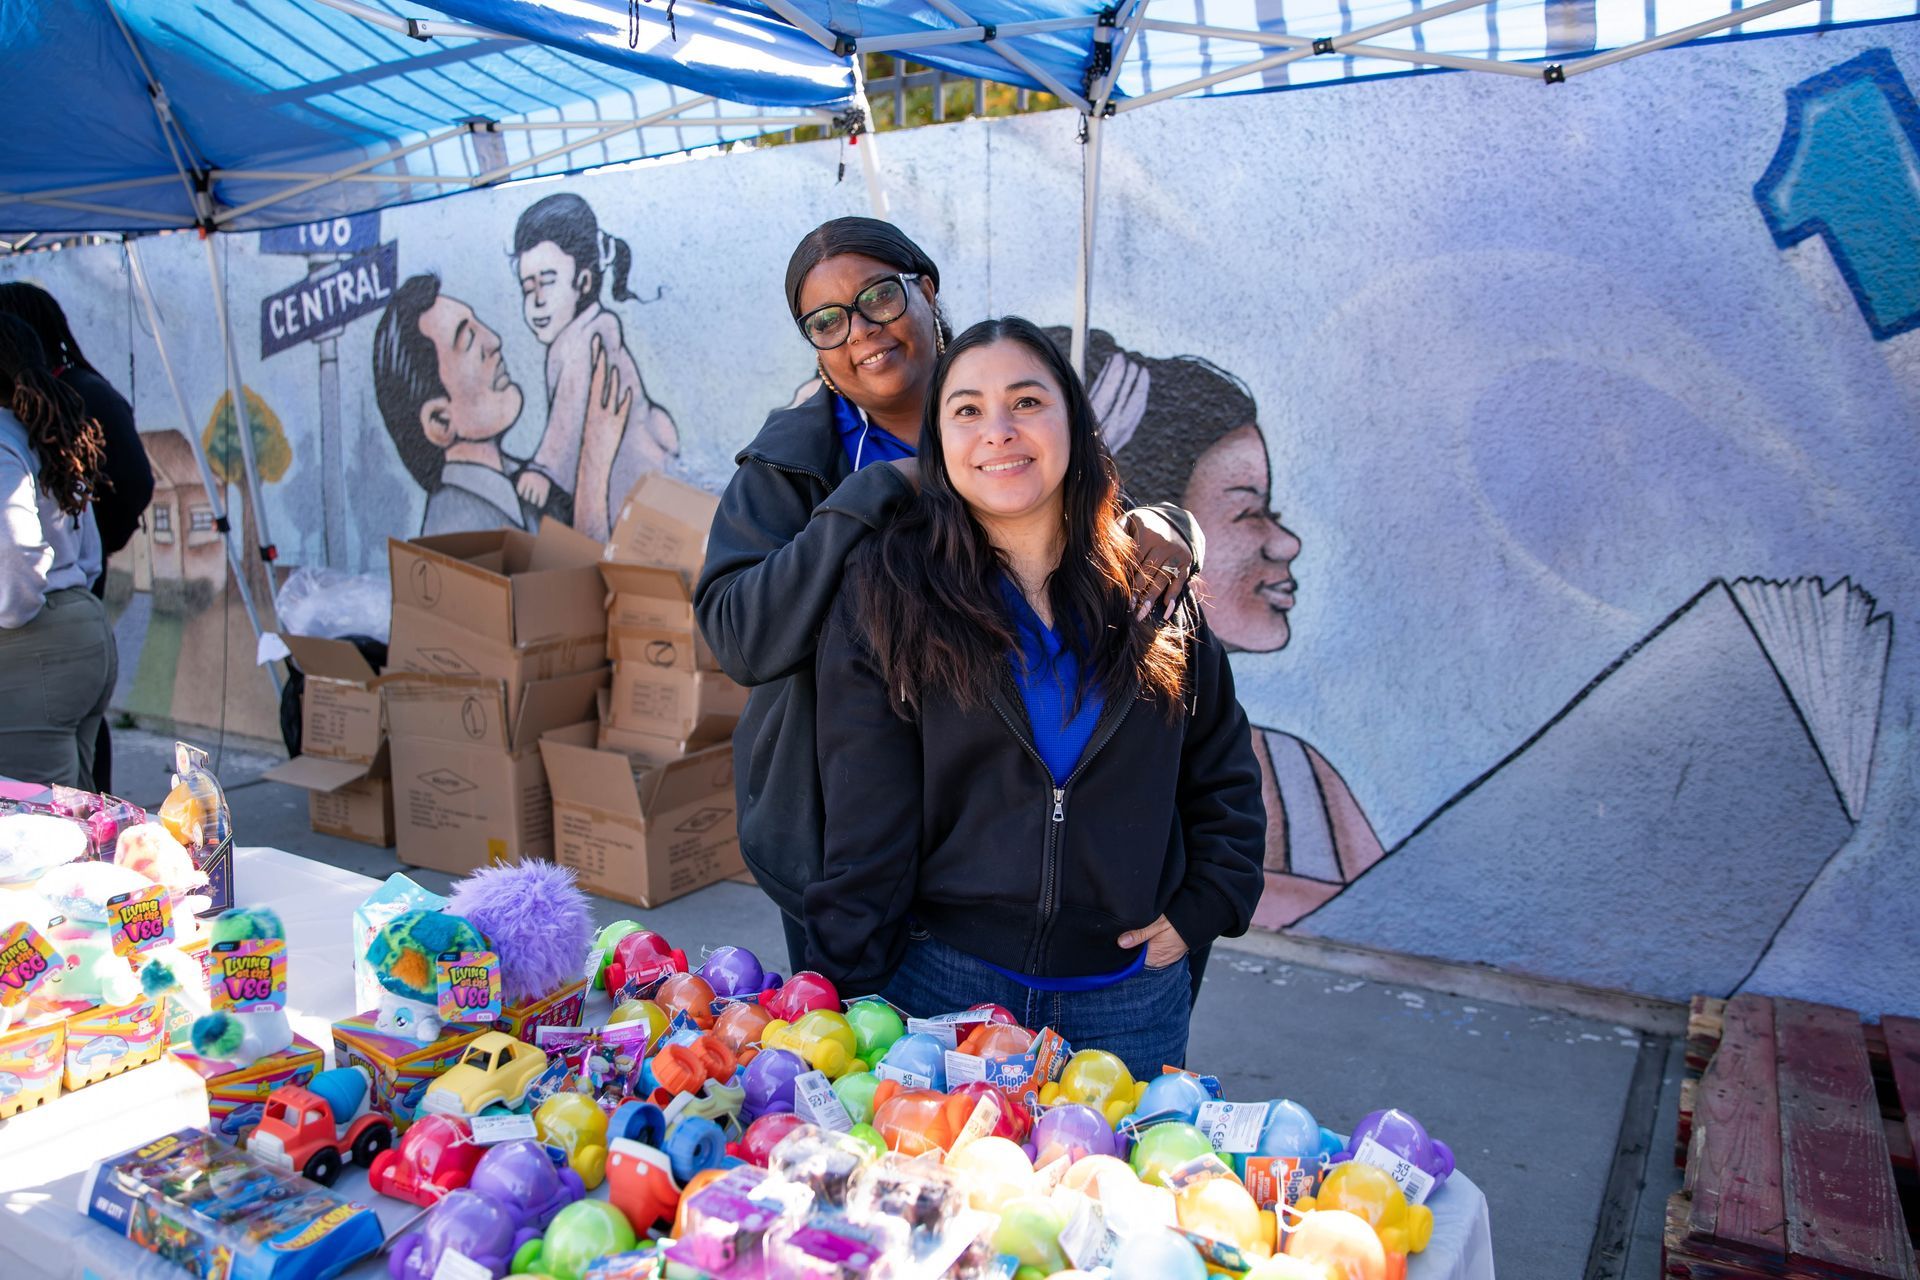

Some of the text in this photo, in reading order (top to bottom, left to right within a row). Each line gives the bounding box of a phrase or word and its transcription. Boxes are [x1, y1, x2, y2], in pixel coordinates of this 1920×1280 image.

[269, 263, 391, 339] CENTRAL
[123, 918, 163, 942] VEG
[224, 977, 272, 1000] VEG
[451, 986, 490, 1008] VEG
[997, 1072, 1028, 1087] Blippi
